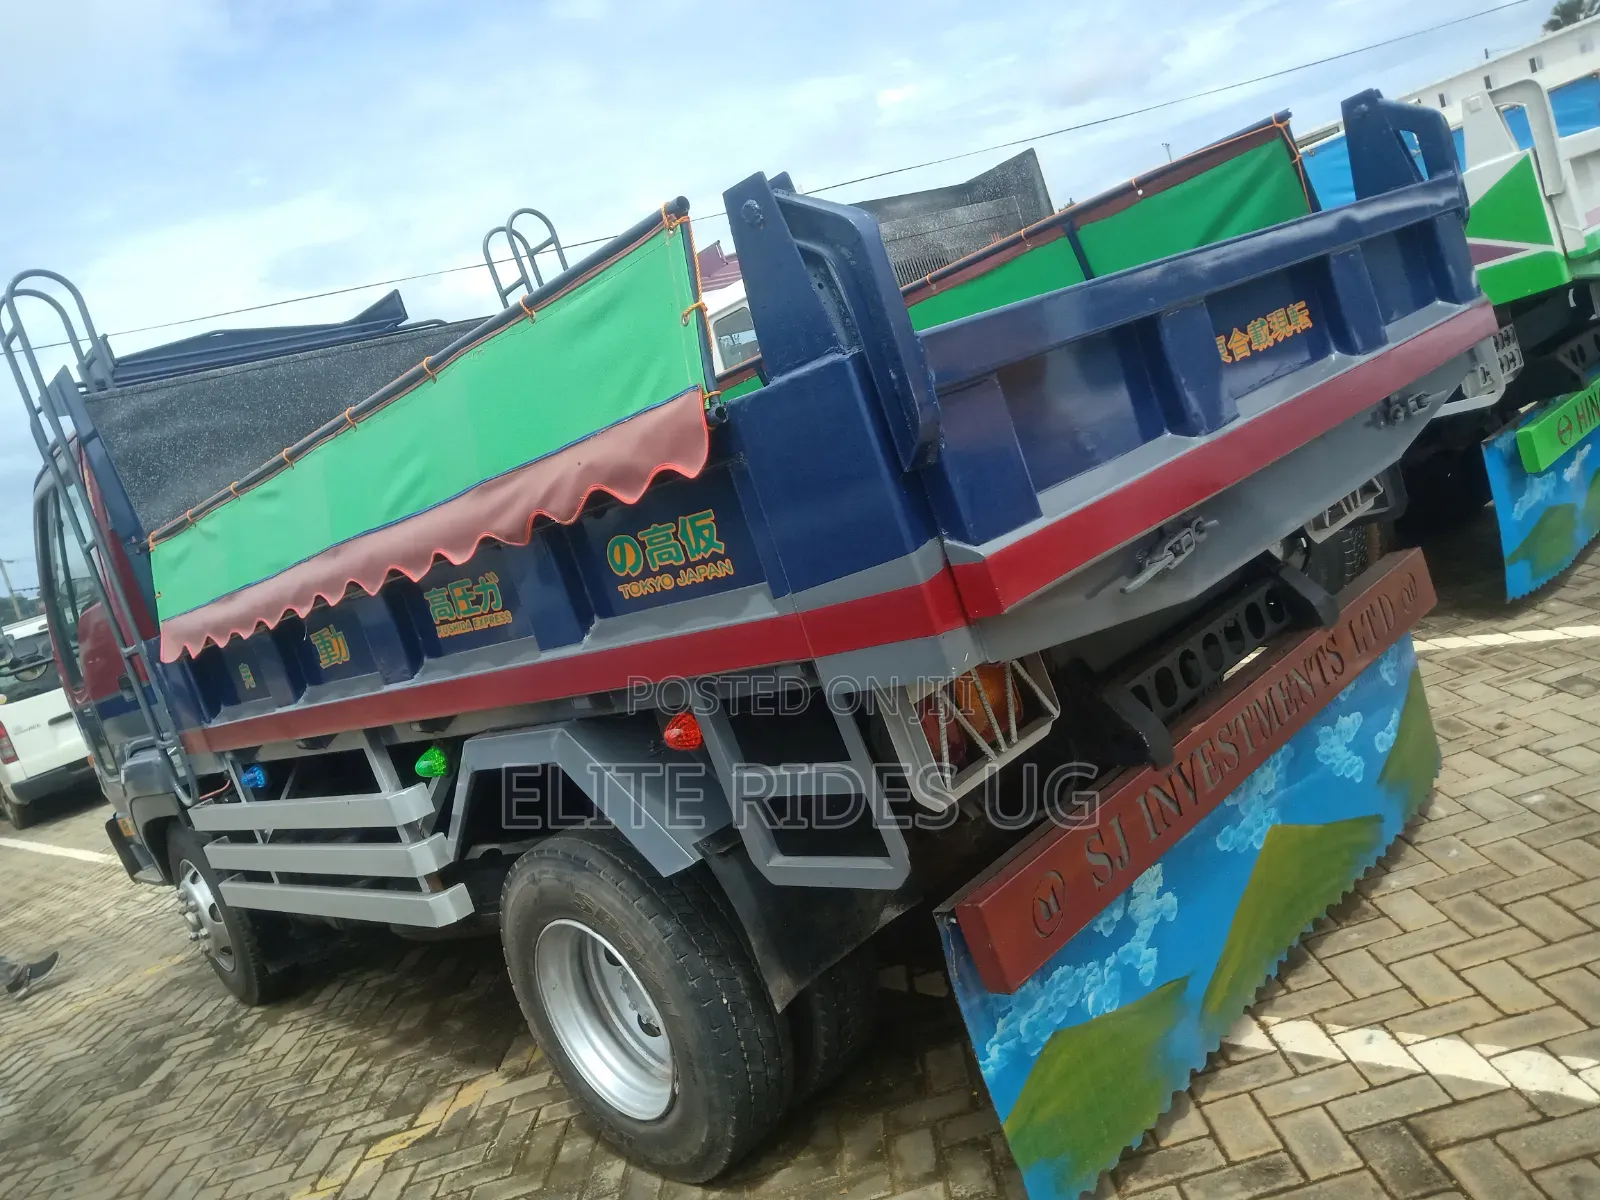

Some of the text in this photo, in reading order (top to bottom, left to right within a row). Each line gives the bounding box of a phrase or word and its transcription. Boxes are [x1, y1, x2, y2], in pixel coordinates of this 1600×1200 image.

[1575, 386, 1600, 434] HIN
[607, 508, 725, 577] の高仮
[424, 571, 503, 623] 高圧ガ
[618, 558, 734, 600] TOKYO JAPAN
[472, 610, 513, 631] EXPRESS
[310, 624, 350, 669] 動
[1085, 593, 1395, 892] SJ INVESTMENTS LTD
